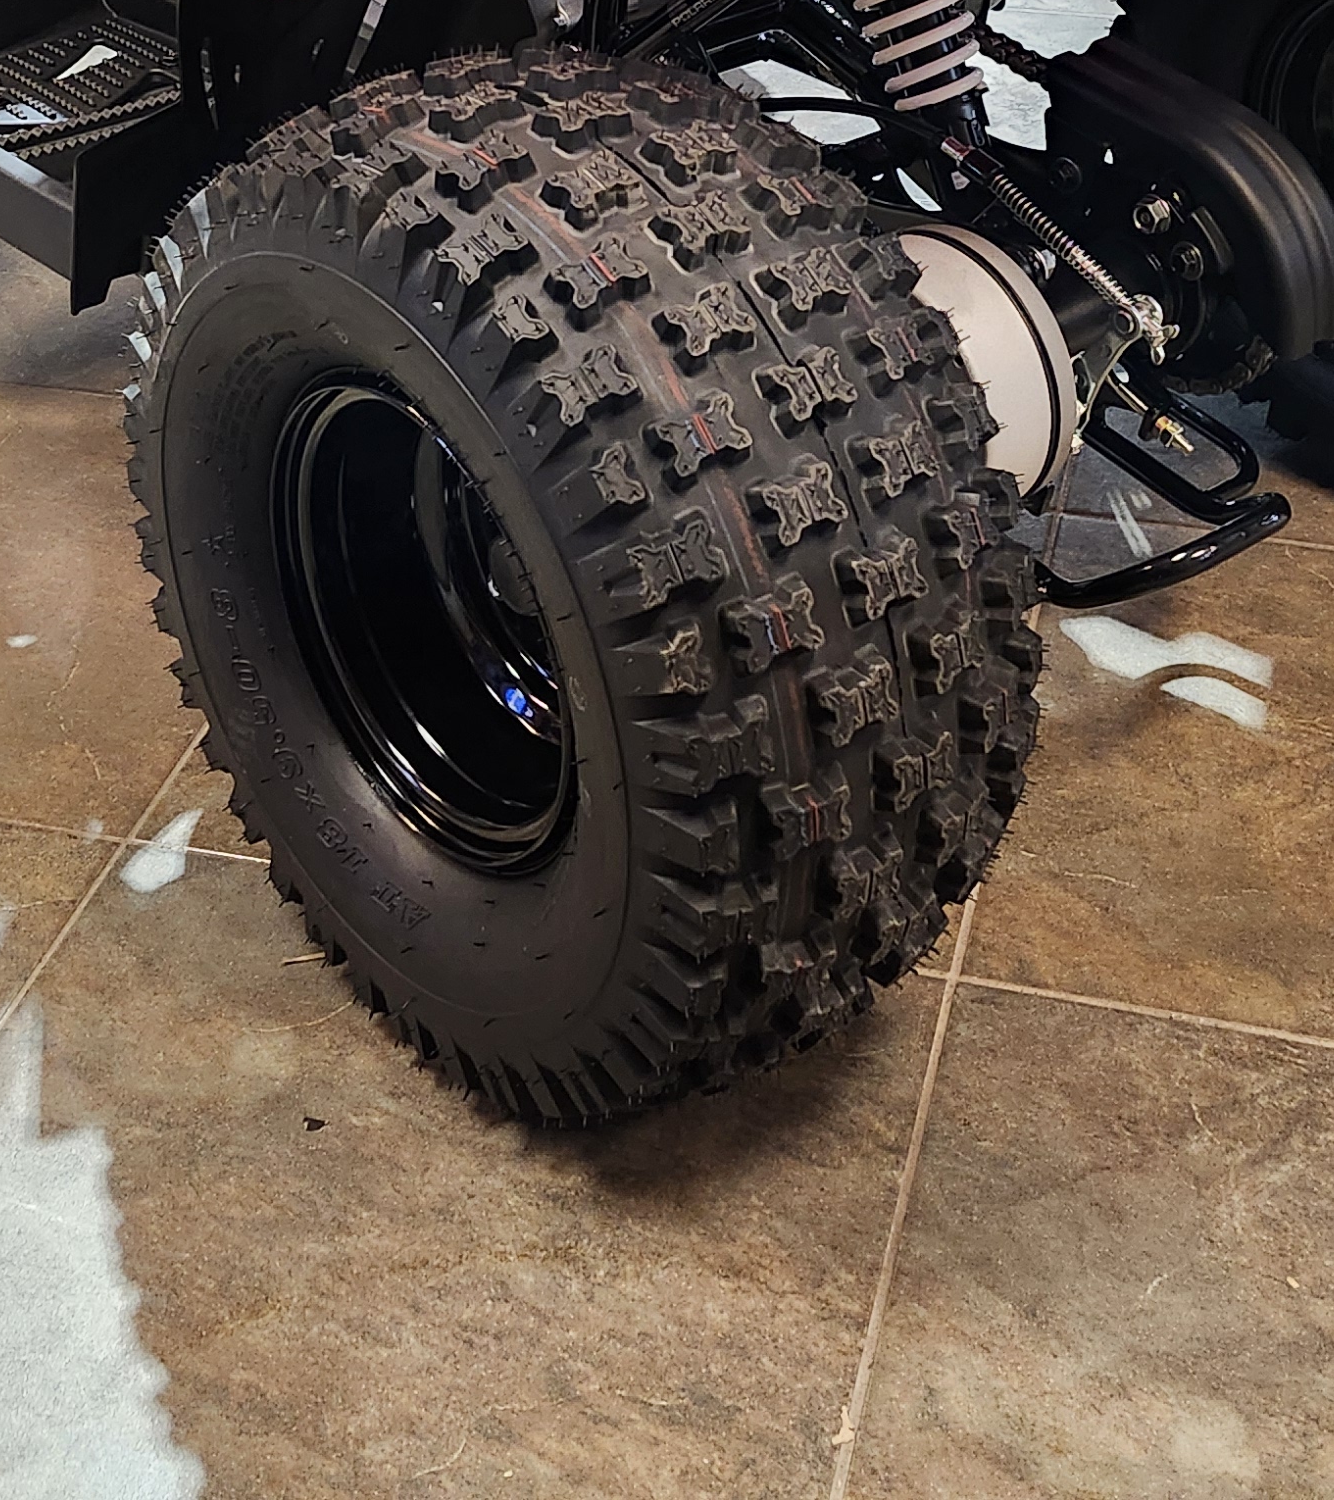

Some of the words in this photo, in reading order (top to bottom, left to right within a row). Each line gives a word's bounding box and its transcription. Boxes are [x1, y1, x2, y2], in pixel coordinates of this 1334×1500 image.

[210, 586, 303, 780] 9.50-8
[315, 818, 369, 875] 18
[371, 881, 433, 931] AT
